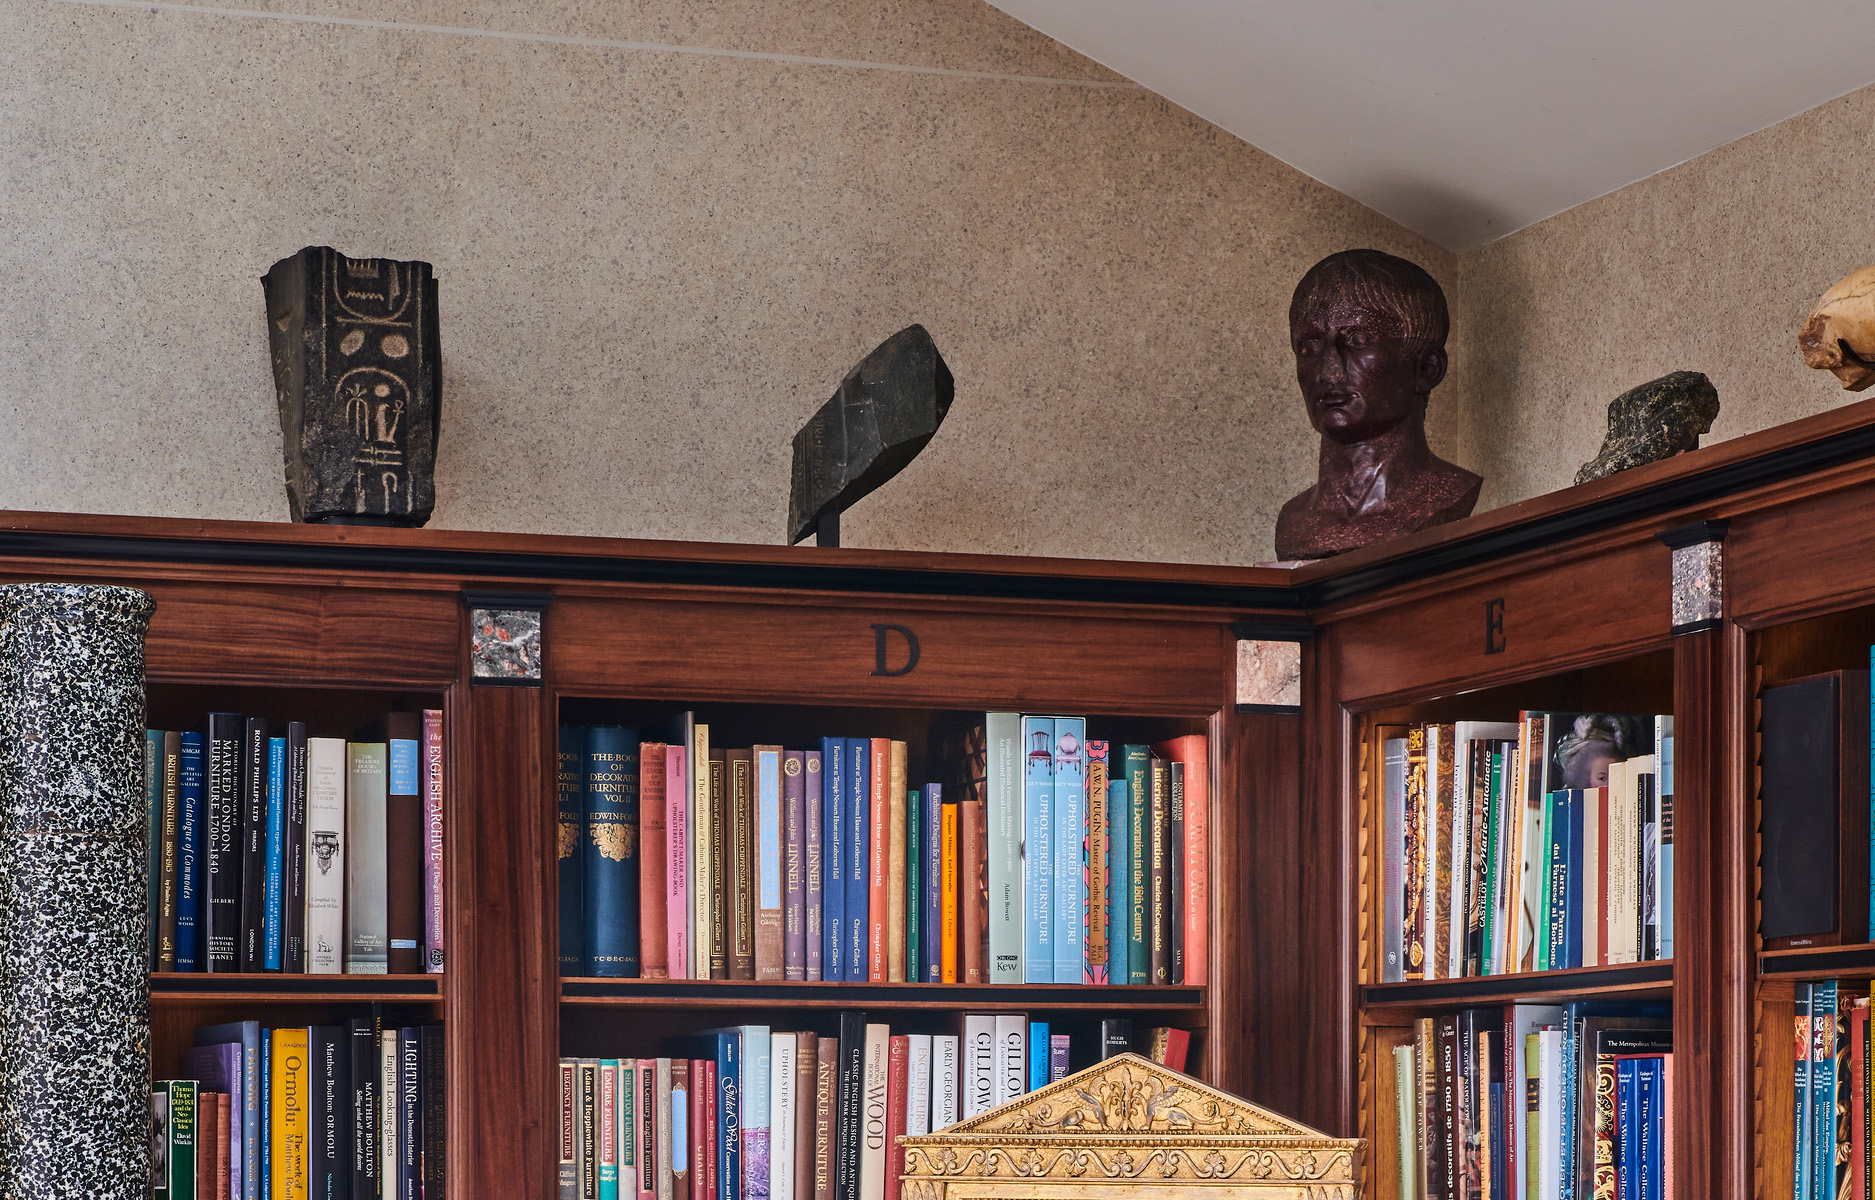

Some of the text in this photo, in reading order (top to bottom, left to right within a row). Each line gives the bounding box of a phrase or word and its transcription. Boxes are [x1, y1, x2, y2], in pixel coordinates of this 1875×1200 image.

[870, 624, 921, 677] D
[1485, 598, 1506, 655] E
[253, 730, 261, 764] RONALD
[166, 754, 177, 835] BRITISH FURNITURE
[211, 740, 220, 809] FURNITURE
[221, 740, 231, 852] MARKED LONDON
[430, 733, 443, 861] the ENGLISH ARCHIVE
[1154, 768, 1163, 808] Interior
[931, 825, 939, 847] Designs
[1093, 801, 1101, 835] PUGIN:
[1480, 751, 1491, 874] Marie-Antoinette
[183, 798, 196, 899] Catalogue of Commodes
[1132, 771, 1143, 942] English Decoration in the 18th Century
[1153, 811, 1163, 869] Decoration
[788, 843, 798, 893] LINNELL
[1067, 795, 1076, 944] UPHOLSTERED FURNITURE
[1093, 867, 1101, 875] of
[1093, 876, 1101, 902] Gothic
[1093, 905, 1101, 932] Revival
[1551, 907, 1559, 917] ai
[997, 962, 1017, 971] Kew
[1550, 920, 1558, 966] Borbone
[248, 1048, 256, 1111] PAKTONG
[326, 1042, 334, 1077] Matthew
[405, 1040, 417, 1102] LIGHTING
[781, 1049, 789, 1109] UPHOLSTERY
[917, 1048, 927, 1095] ENGLISH
[944, 1041, 953, 1123] EARLY GEORGIAN
[285, 1056, 301, 1126] Ormolu:
[326, 1080, 334, 1113] Boulton:
[385, 1055, 395, 1156] English Looking-glasses
[604, 1071, 612, 1106] EMPIRE
[295, 1133, 303, 1151] The
[585, 1104, 593, 1155] Hepplewhite
[817, 1061, 830, 1190] ANTIQUE FURNITURE
[866, 1085, 885, 1150] WOOD
[1446, 1116, 1452, 1129] de
[284, 1133, 294, 1174] Matthew
[365, 1133, 373, 1177] BOULTON
[295, 1180, 303, 1190] of
